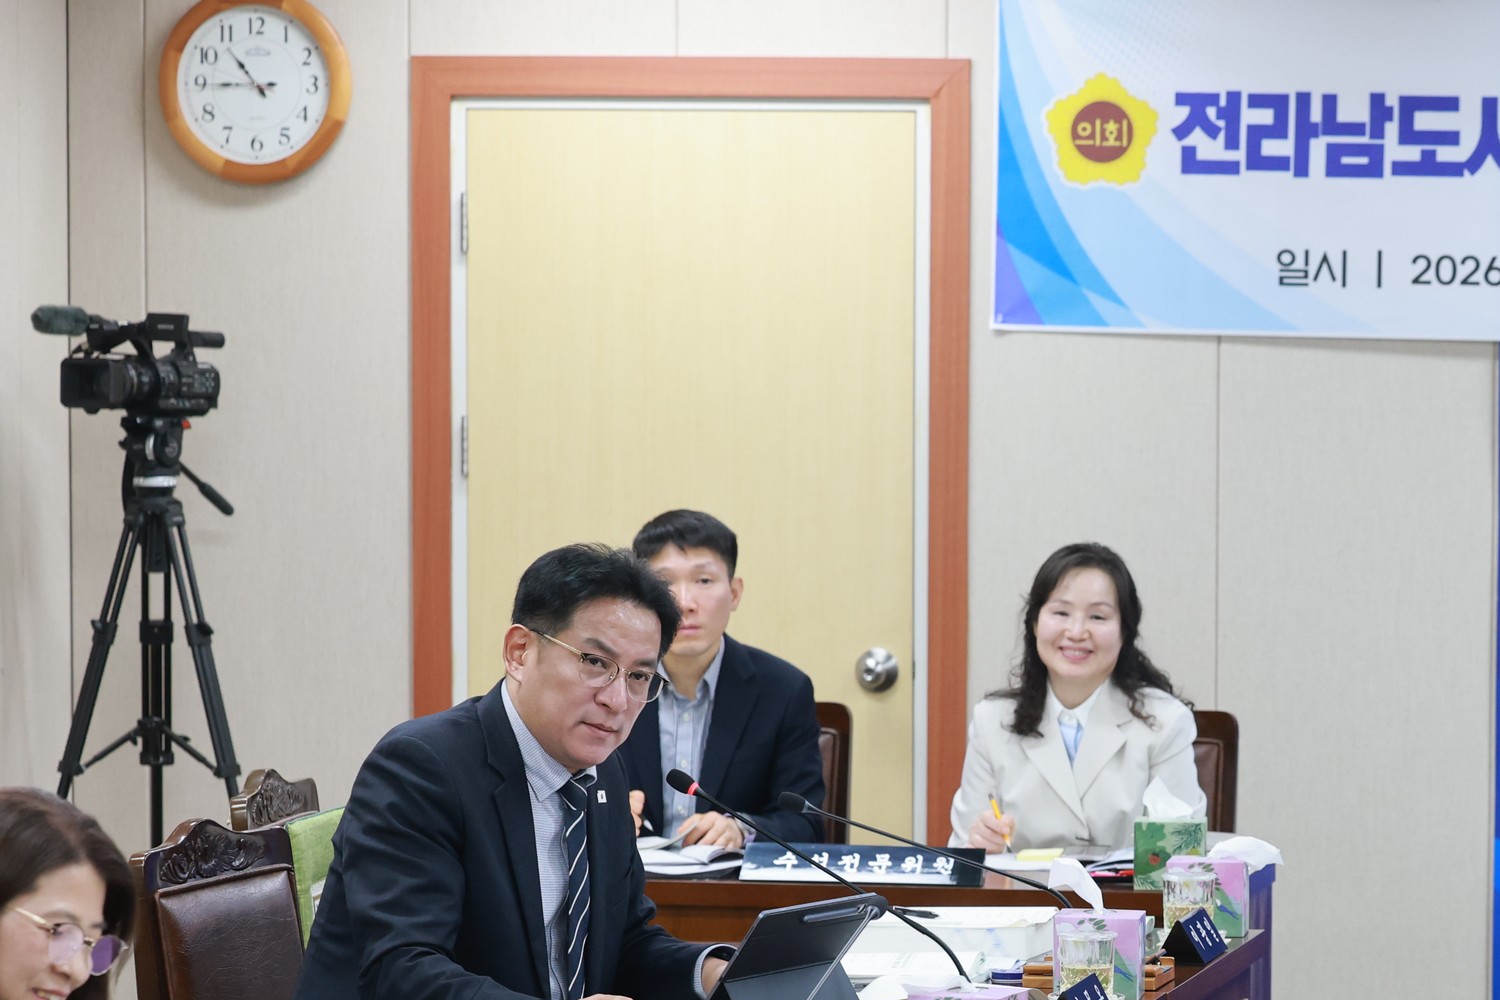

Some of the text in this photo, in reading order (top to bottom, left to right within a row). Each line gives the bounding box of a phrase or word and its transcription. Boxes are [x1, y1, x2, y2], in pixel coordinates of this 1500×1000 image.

[220, 24, 233, 43] 11
[248, 16, 265, 35] 12
[199, 46, 219, 65] 10
[301, 48, 313, 66] 2
[194, 74, 207, 92] 9
[305, 75, 319, 95] 3
[201, 103, 215, 123] 8
[296, 104, 309, 123] 4
[222, 126, 234, 145] 7
[278, 127, 291, 146] 5
[1074, 117, 1129, 148] 의회
[250, 134, 264, 152] 6
[1276, 249, 1349, 290] 일시
